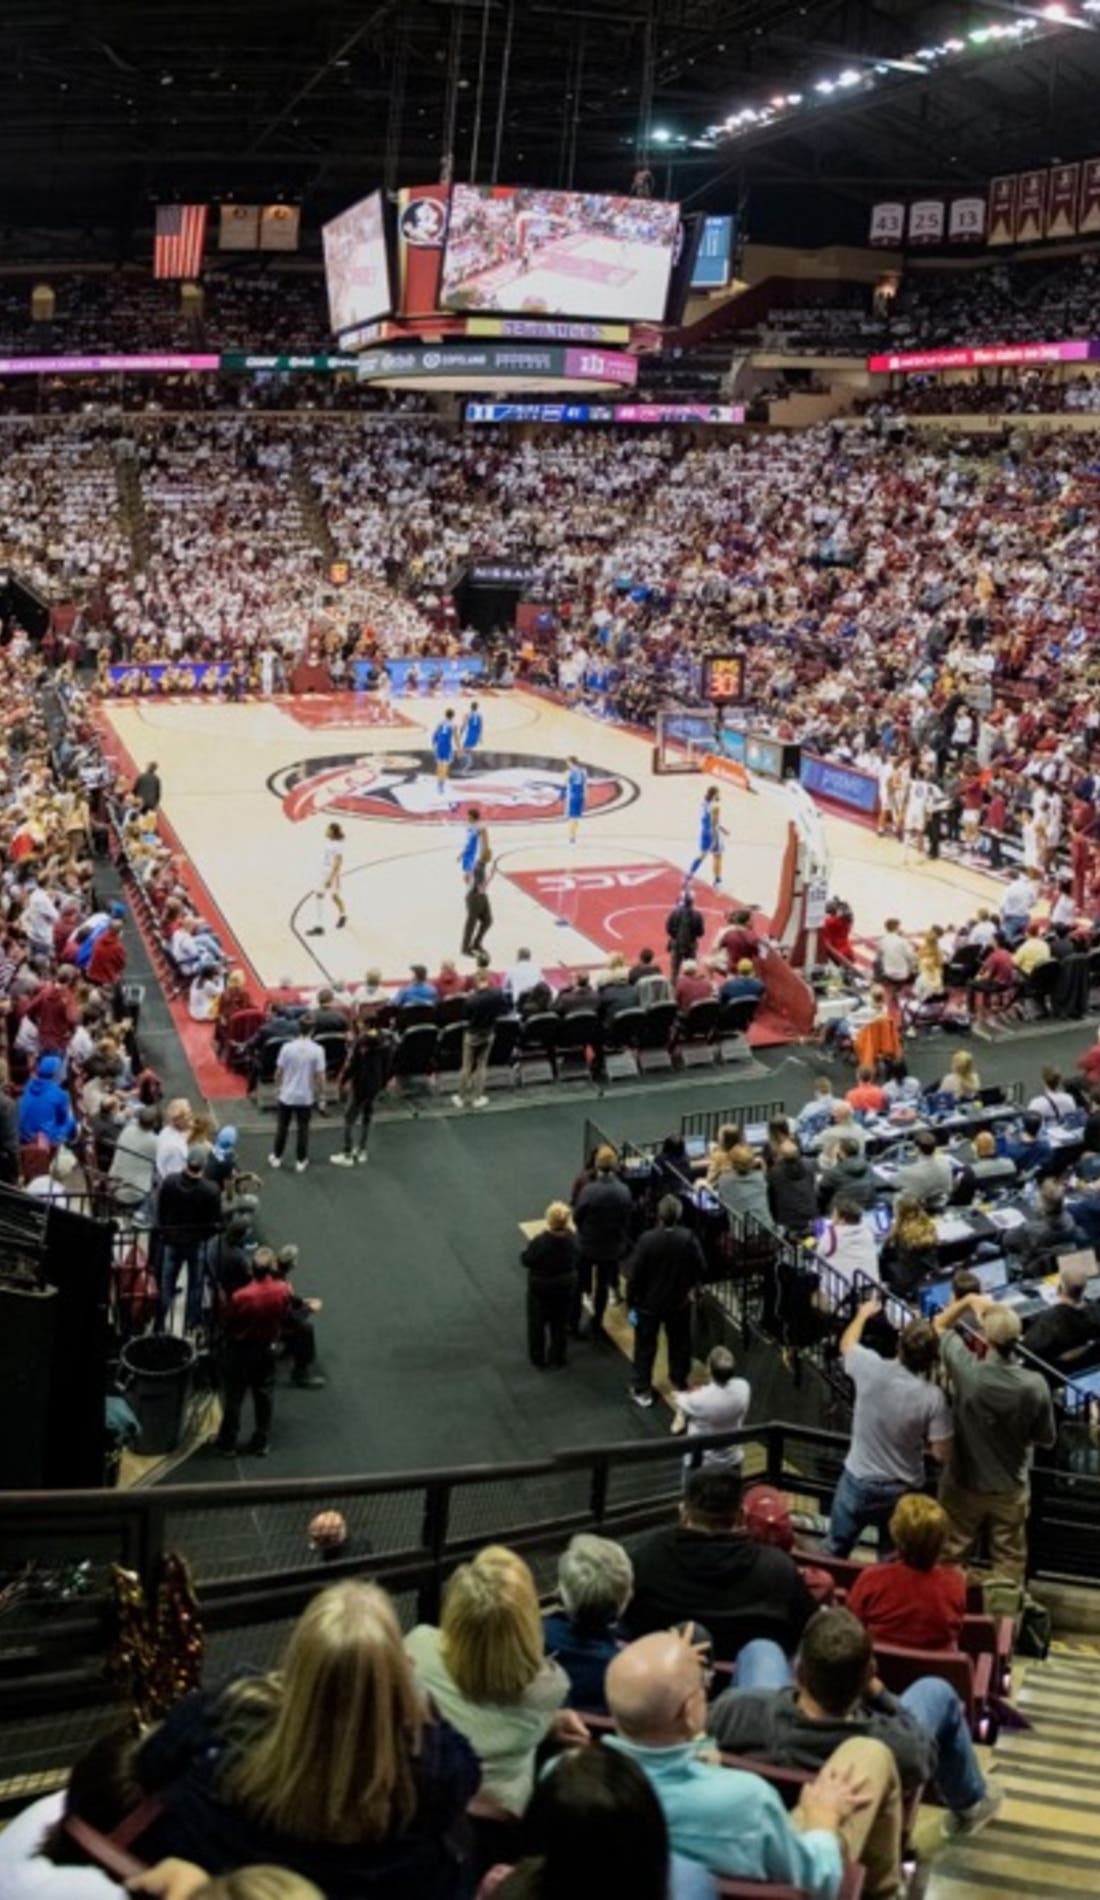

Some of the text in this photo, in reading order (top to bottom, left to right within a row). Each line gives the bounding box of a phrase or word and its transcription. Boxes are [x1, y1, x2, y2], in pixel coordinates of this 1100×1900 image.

[876, 216, 898, 231] 43
[915, 215, 938, 229] 25
[959, 211, 977, 227] 13
